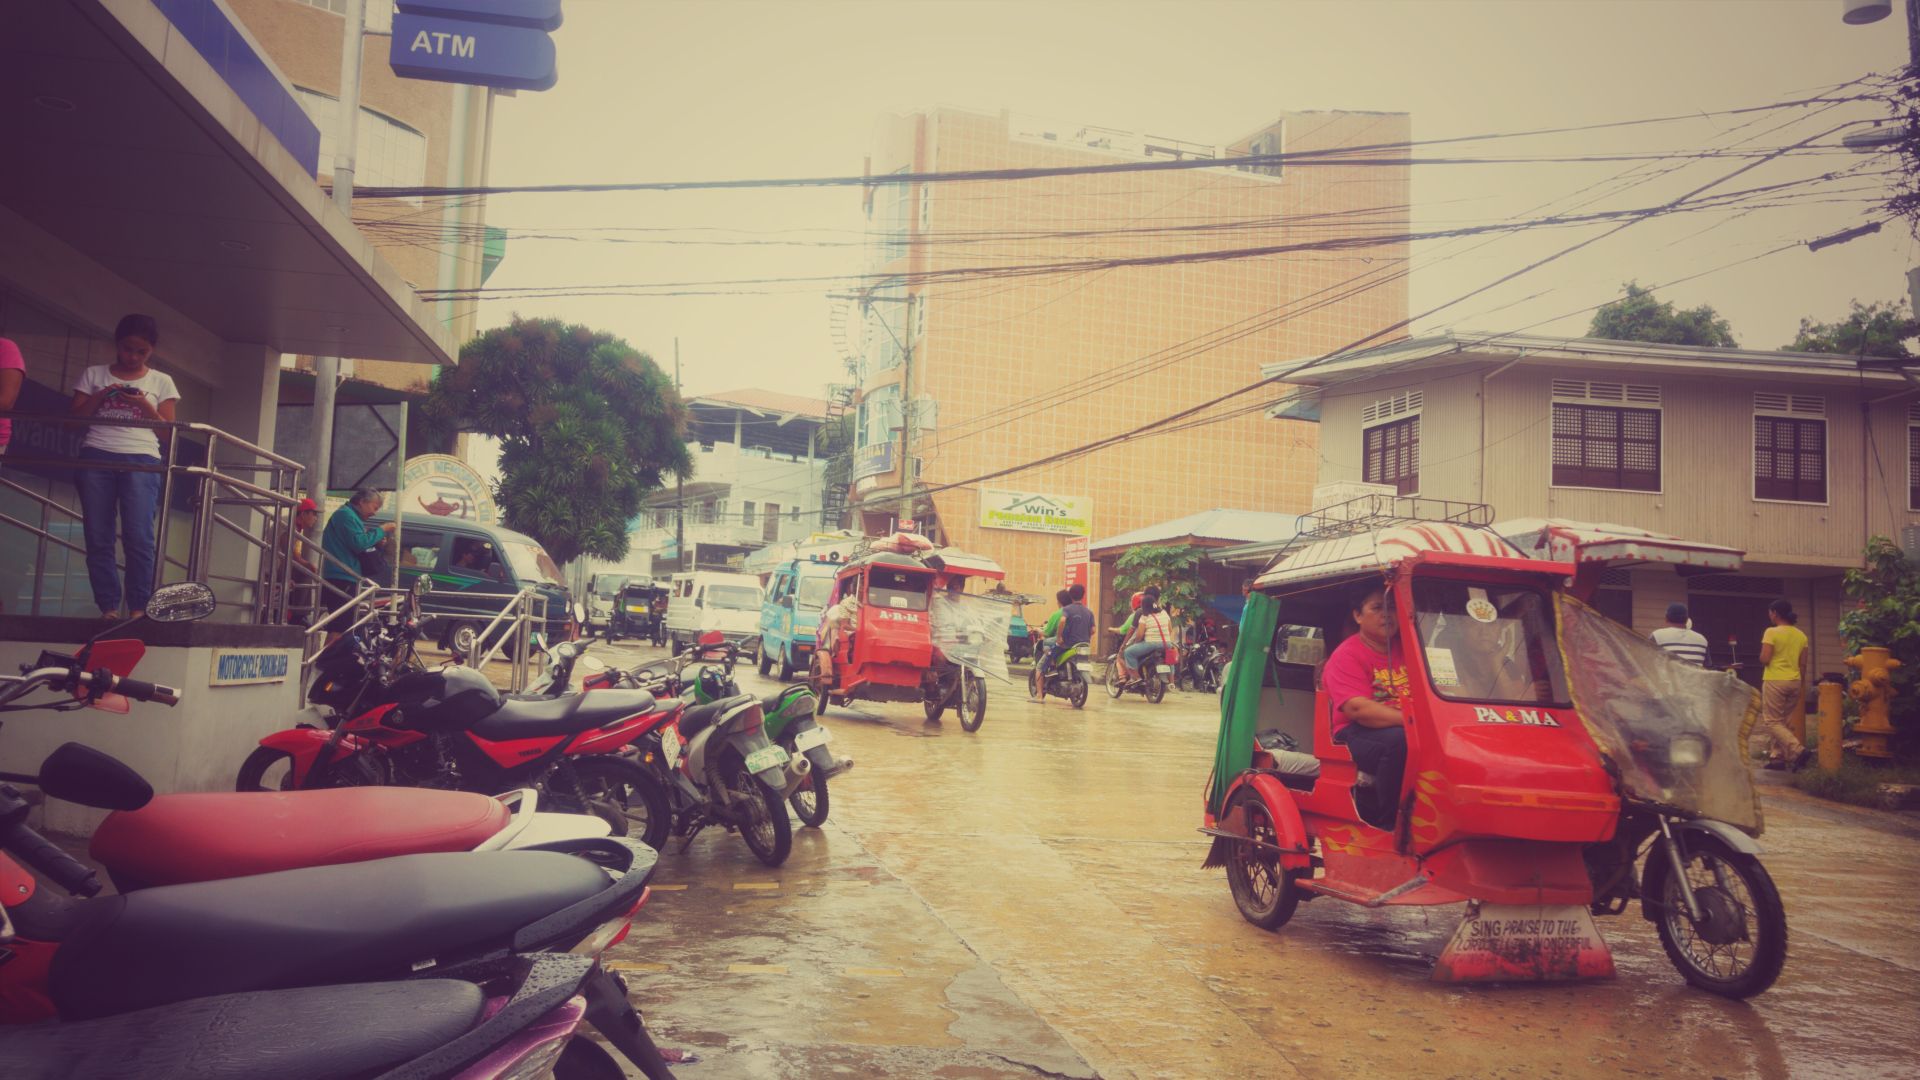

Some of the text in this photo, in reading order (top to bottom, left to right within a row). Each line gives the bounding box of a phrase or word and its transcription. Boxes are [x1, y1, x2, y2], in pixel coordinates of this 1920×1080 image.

[411, 30, 476, 58] ATM
[1024, 504, 1067, 517] Win's
[217, 654, 258, 680] MOTORCYCLE
[258, 655, 277, 678] PARKING
[1474, 706, 1560, 727] PA & MA
[1470, 920, 1502, 937] SING
[1502, 919, 1540, 935] PRAISE
[1541, 919, 1556, 935] TO
